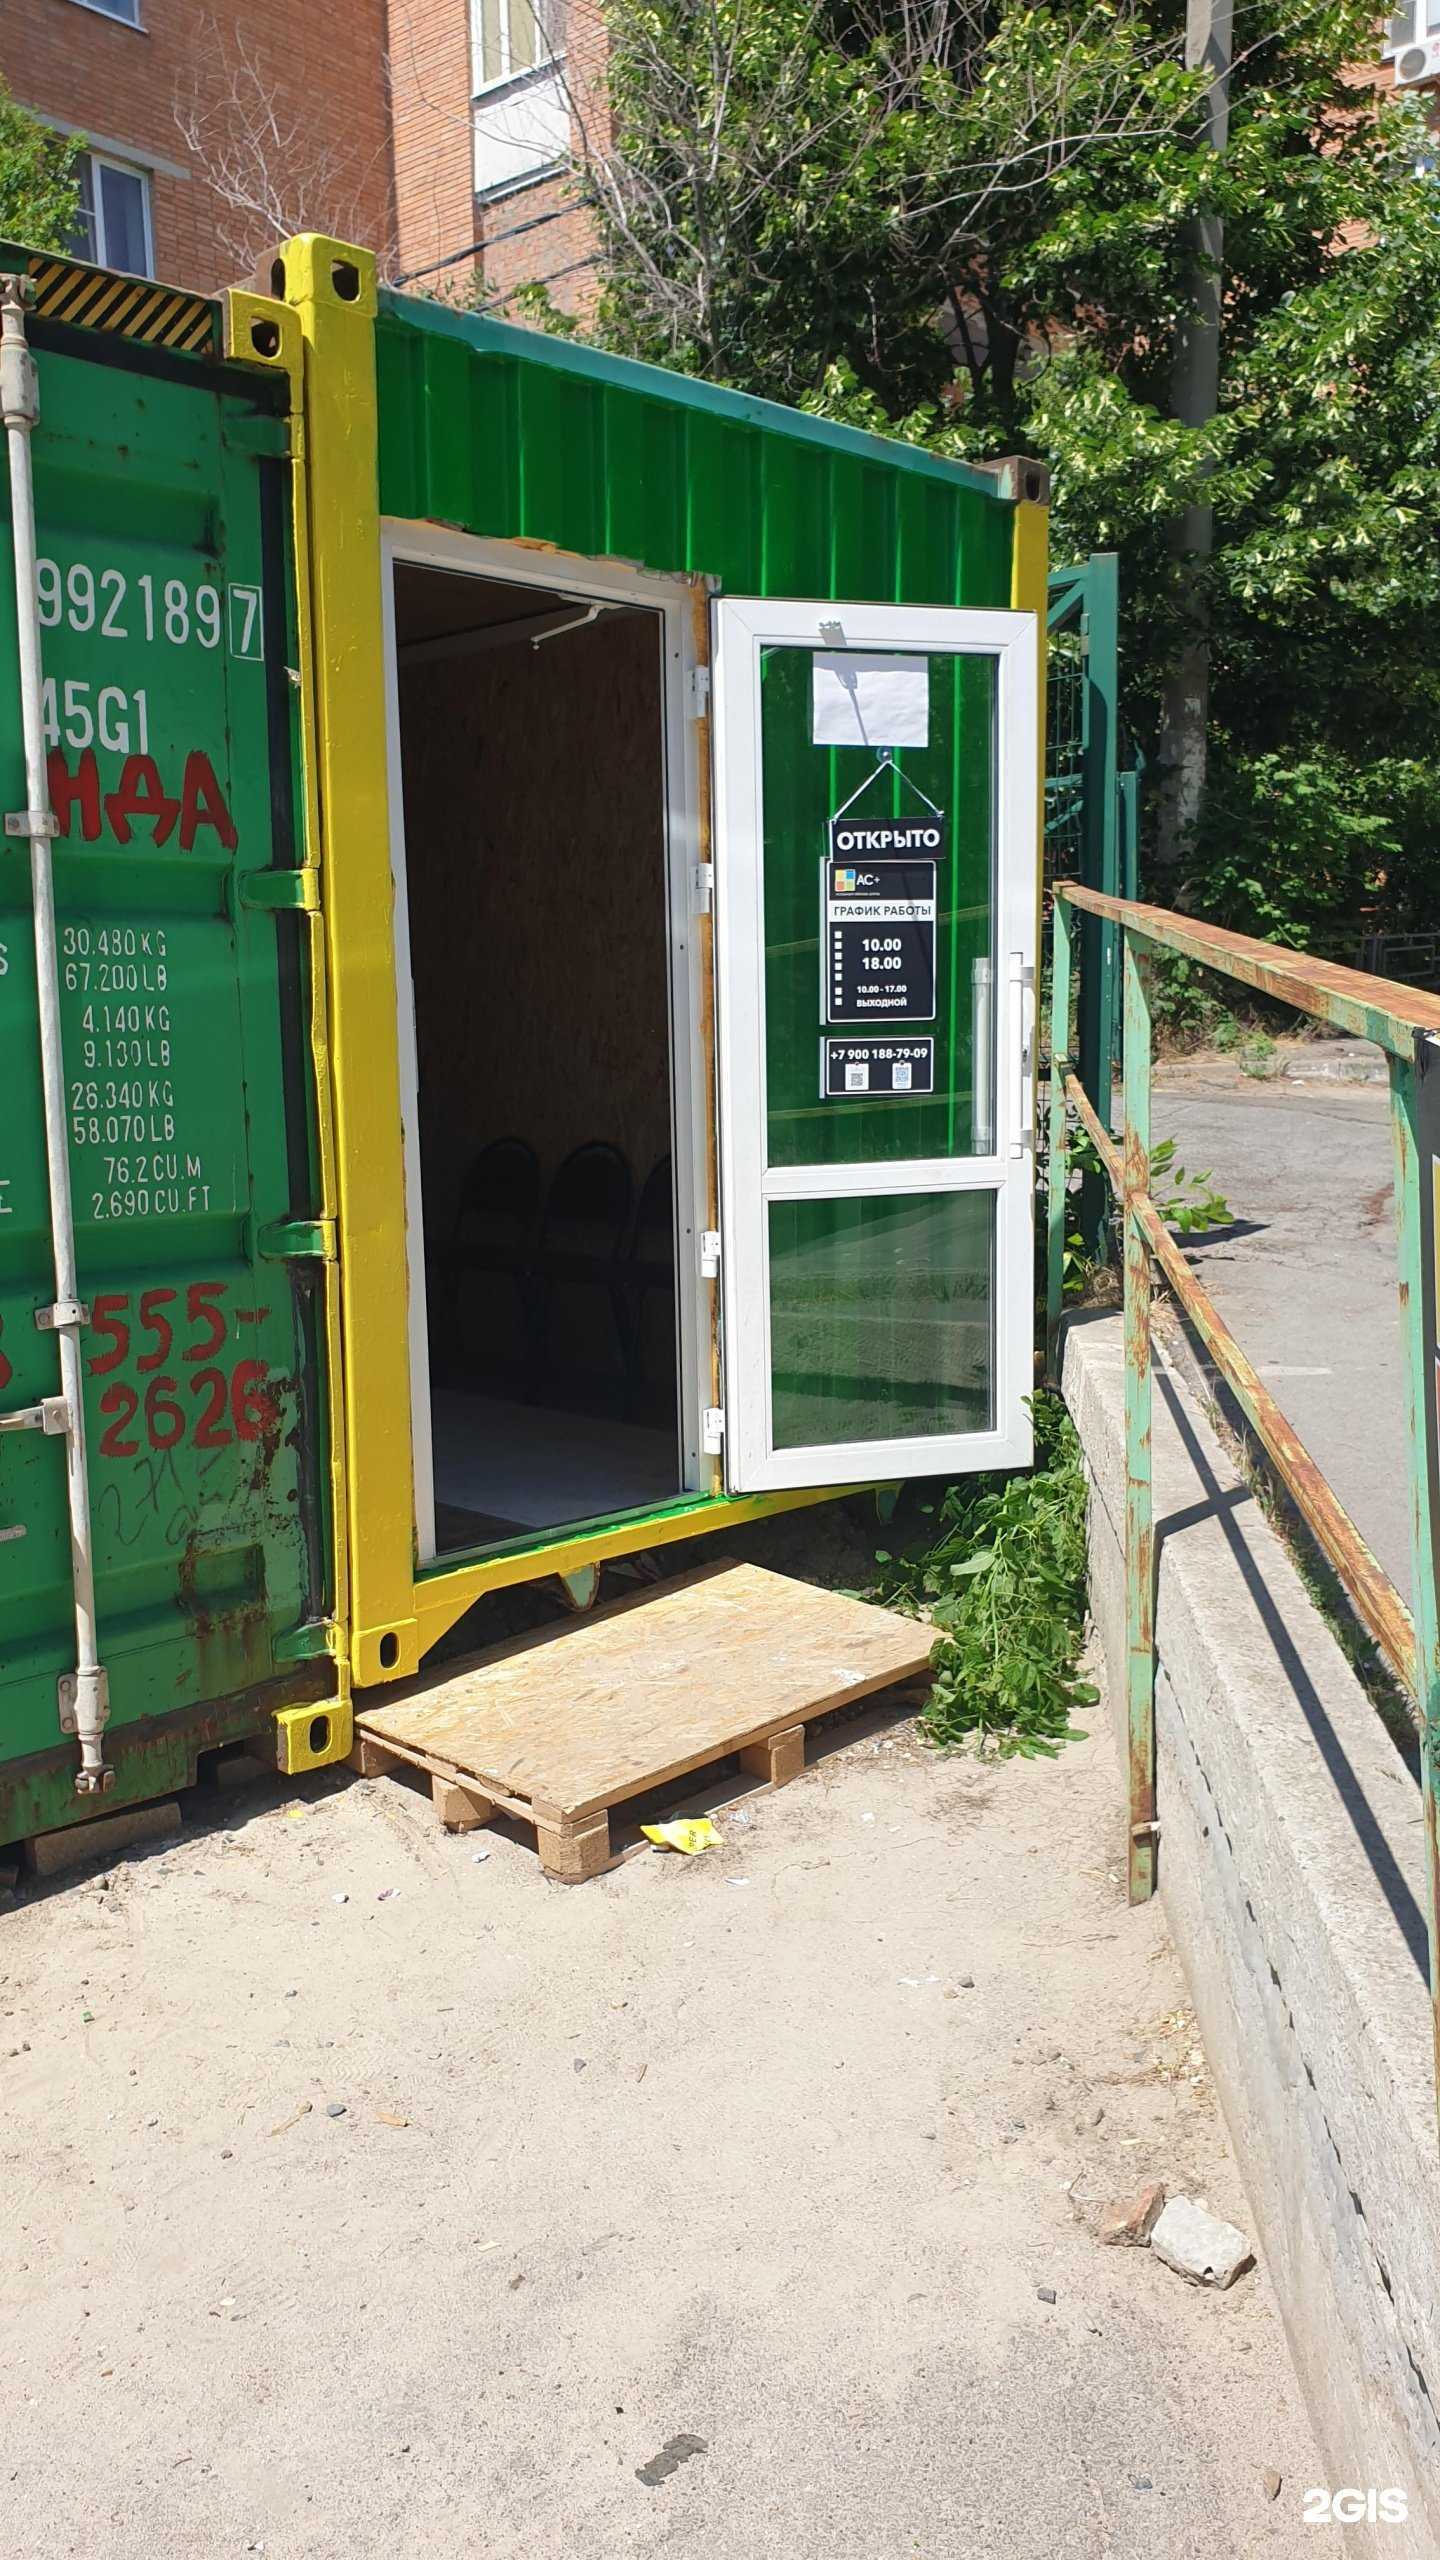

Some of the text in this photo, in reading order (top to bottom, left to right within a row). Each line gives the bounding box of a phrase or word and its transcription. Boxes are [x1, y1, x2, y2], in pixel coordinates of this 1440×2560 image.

[40, 677, 148, 755] 45G1
[836, 828, 940, 850] ОТКРЫТО
[833, 905, 931, 917] ГРАФИК РАБОТЫ
[862, 938, 902, 952] 10.00
[862, 957, 902, 970] 18.00
[856, 997, 907, 1008] ВЫХОДНОЙ
[830, 1048, 928, 1060] +7 900 188-79-09
[100, 1359, 280, 1456] 2626
